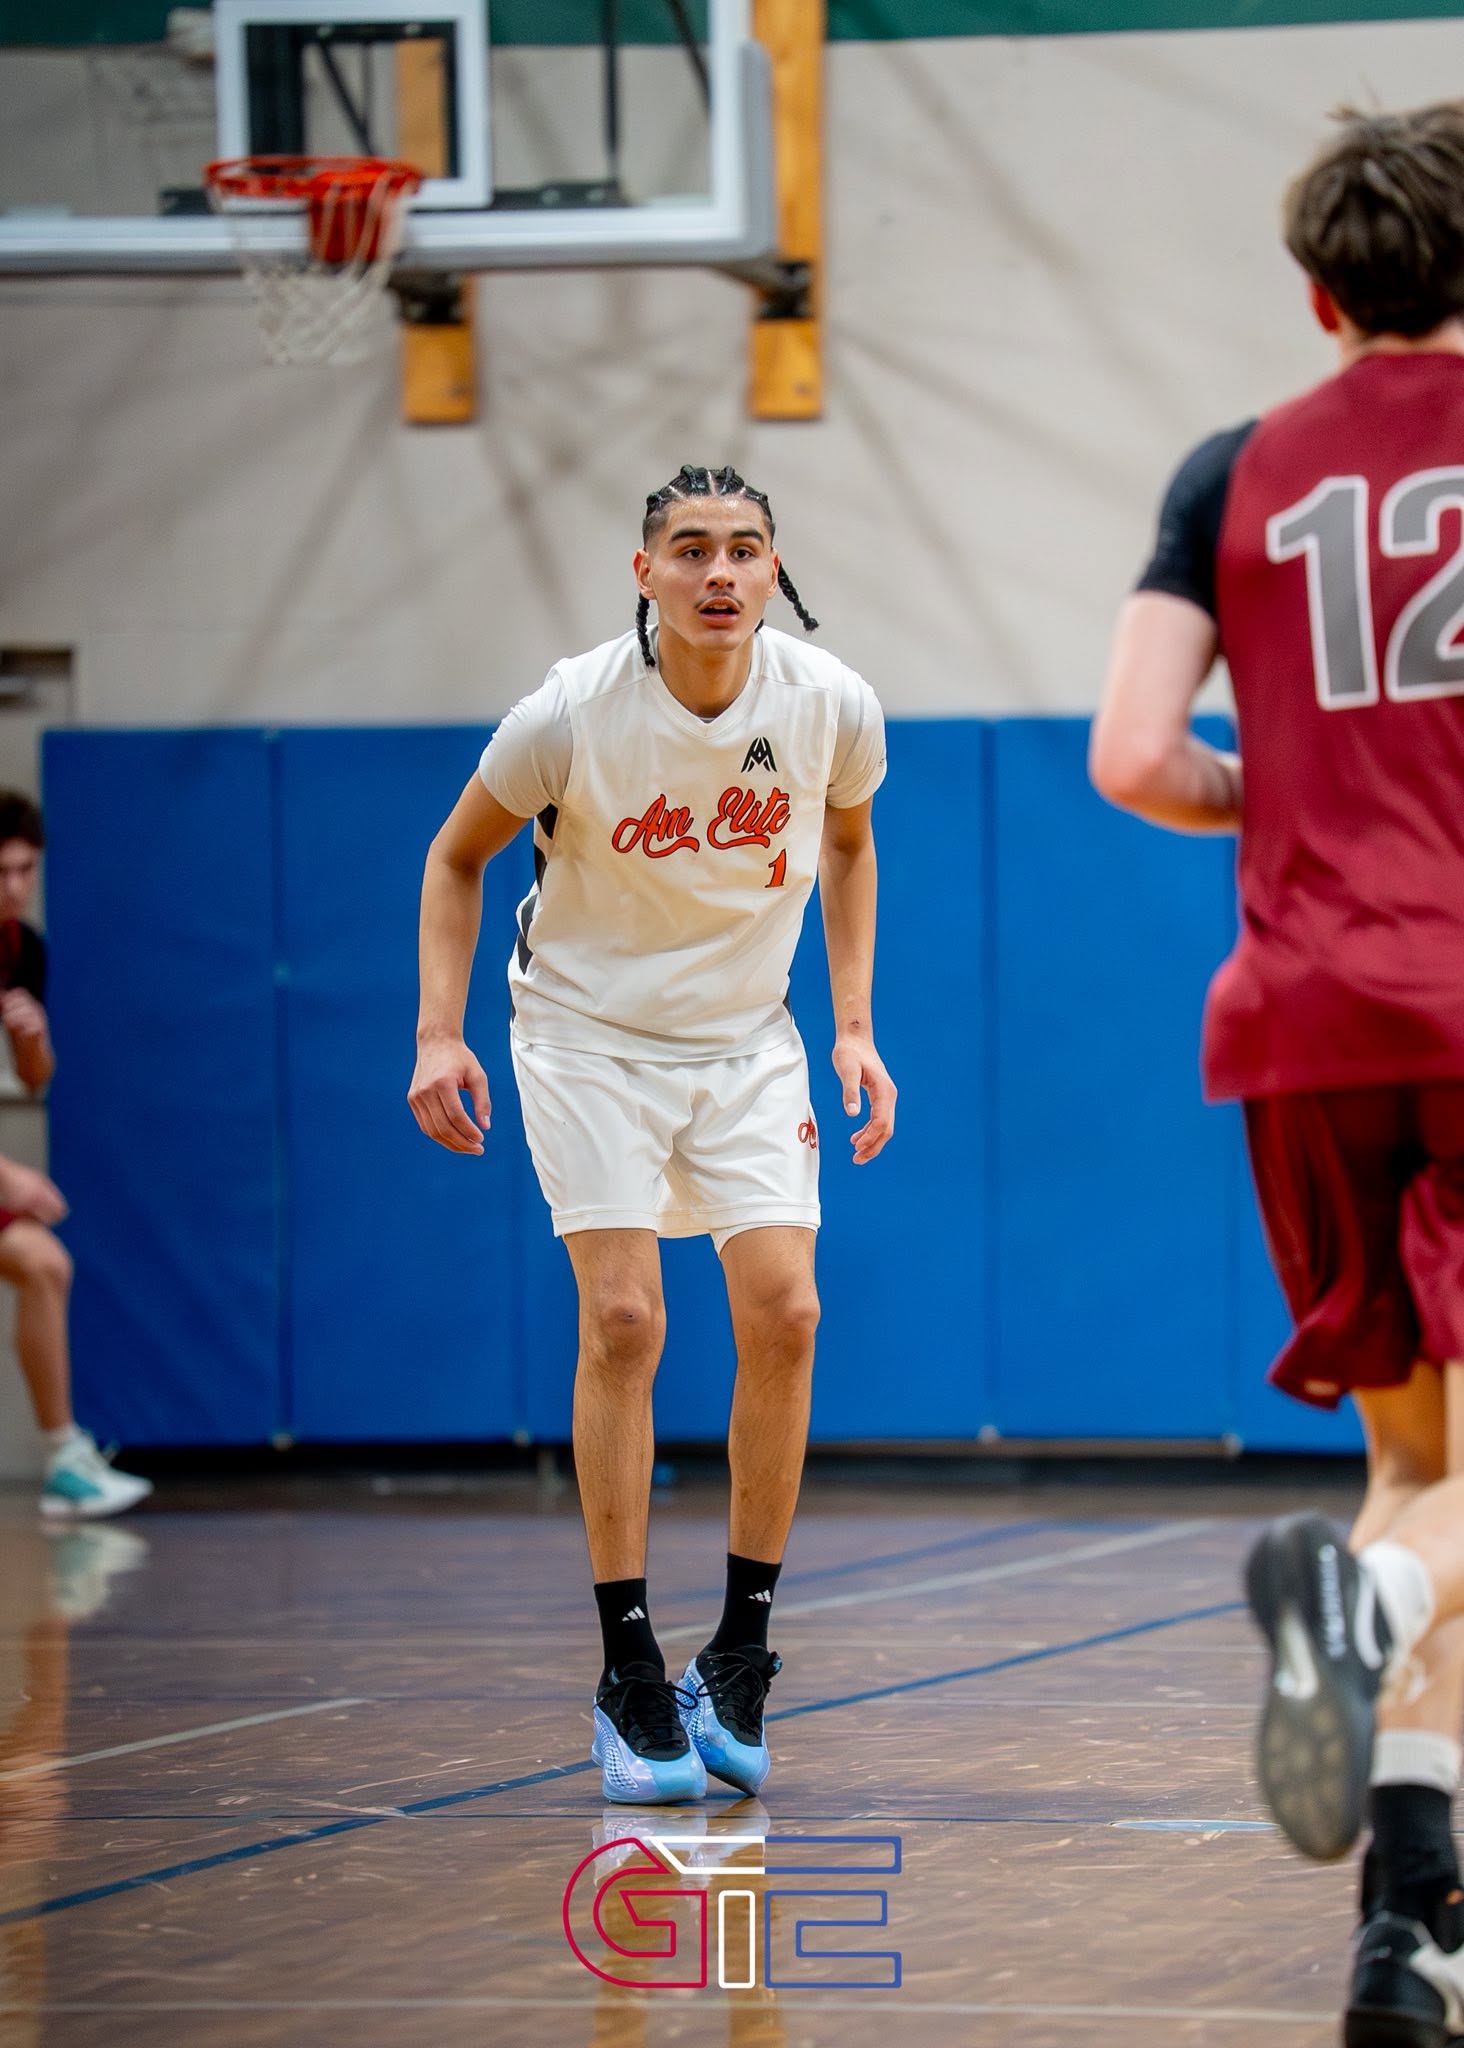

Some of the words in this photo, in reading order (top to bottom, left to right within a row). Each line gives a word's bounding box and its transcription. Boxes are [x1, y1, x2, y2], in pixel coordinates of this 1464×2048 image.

[1265, 464, 1464, 712] 12
[611, 793, 700, 858] Am
[707, 786, 791, 850] Elite
[765, 848, 786, 888] 1
